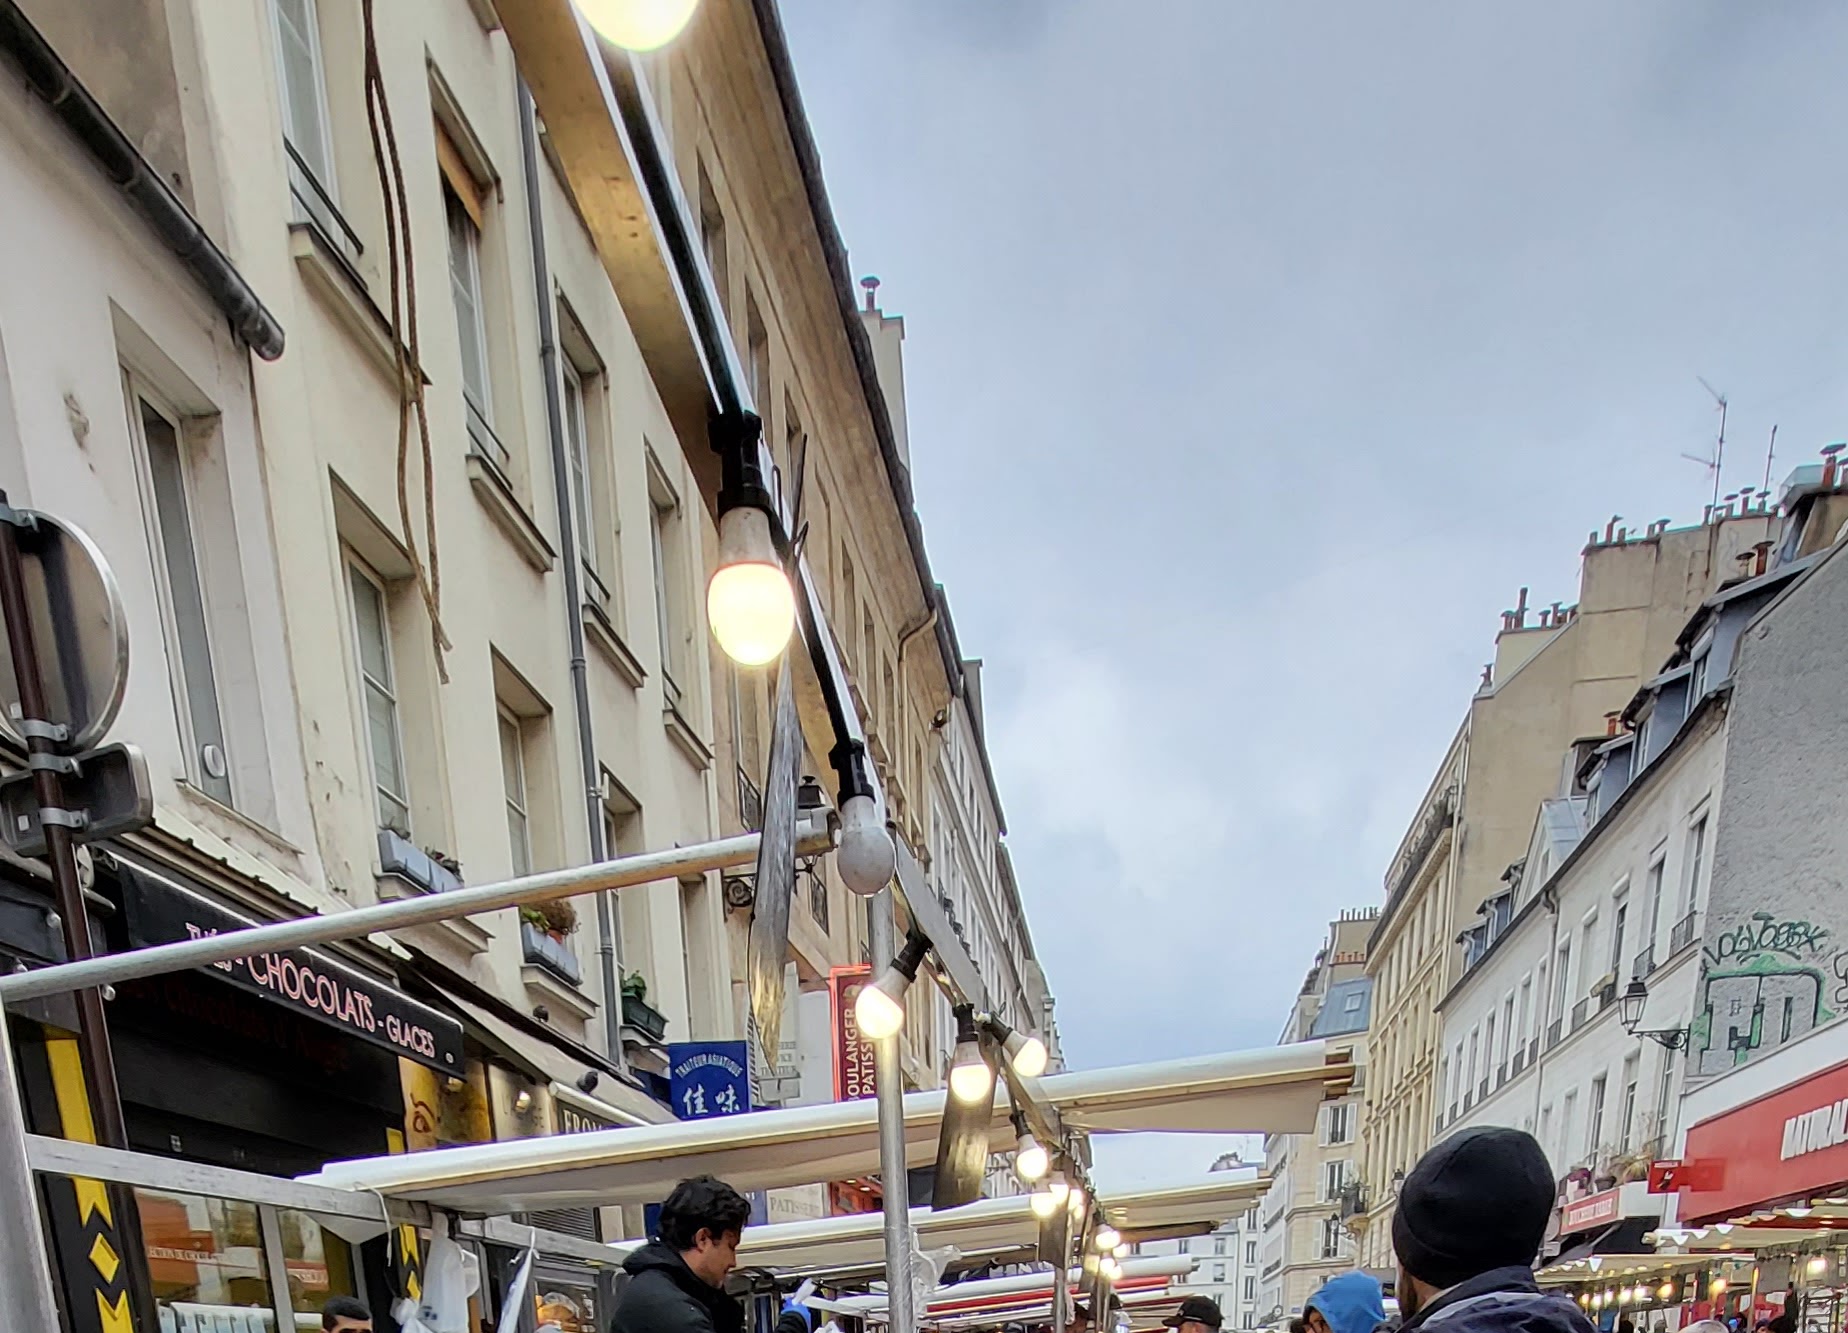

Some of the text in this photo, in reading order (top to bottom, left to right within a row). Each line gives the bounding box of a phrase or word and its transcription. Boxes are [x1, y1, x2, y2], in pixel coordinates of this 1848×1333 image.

[247, 953, 376, 1033] CHOCOLATS
[386, 1015, 436, 1058] GLACES
[683, 1083, 740, 1116] 佳味
